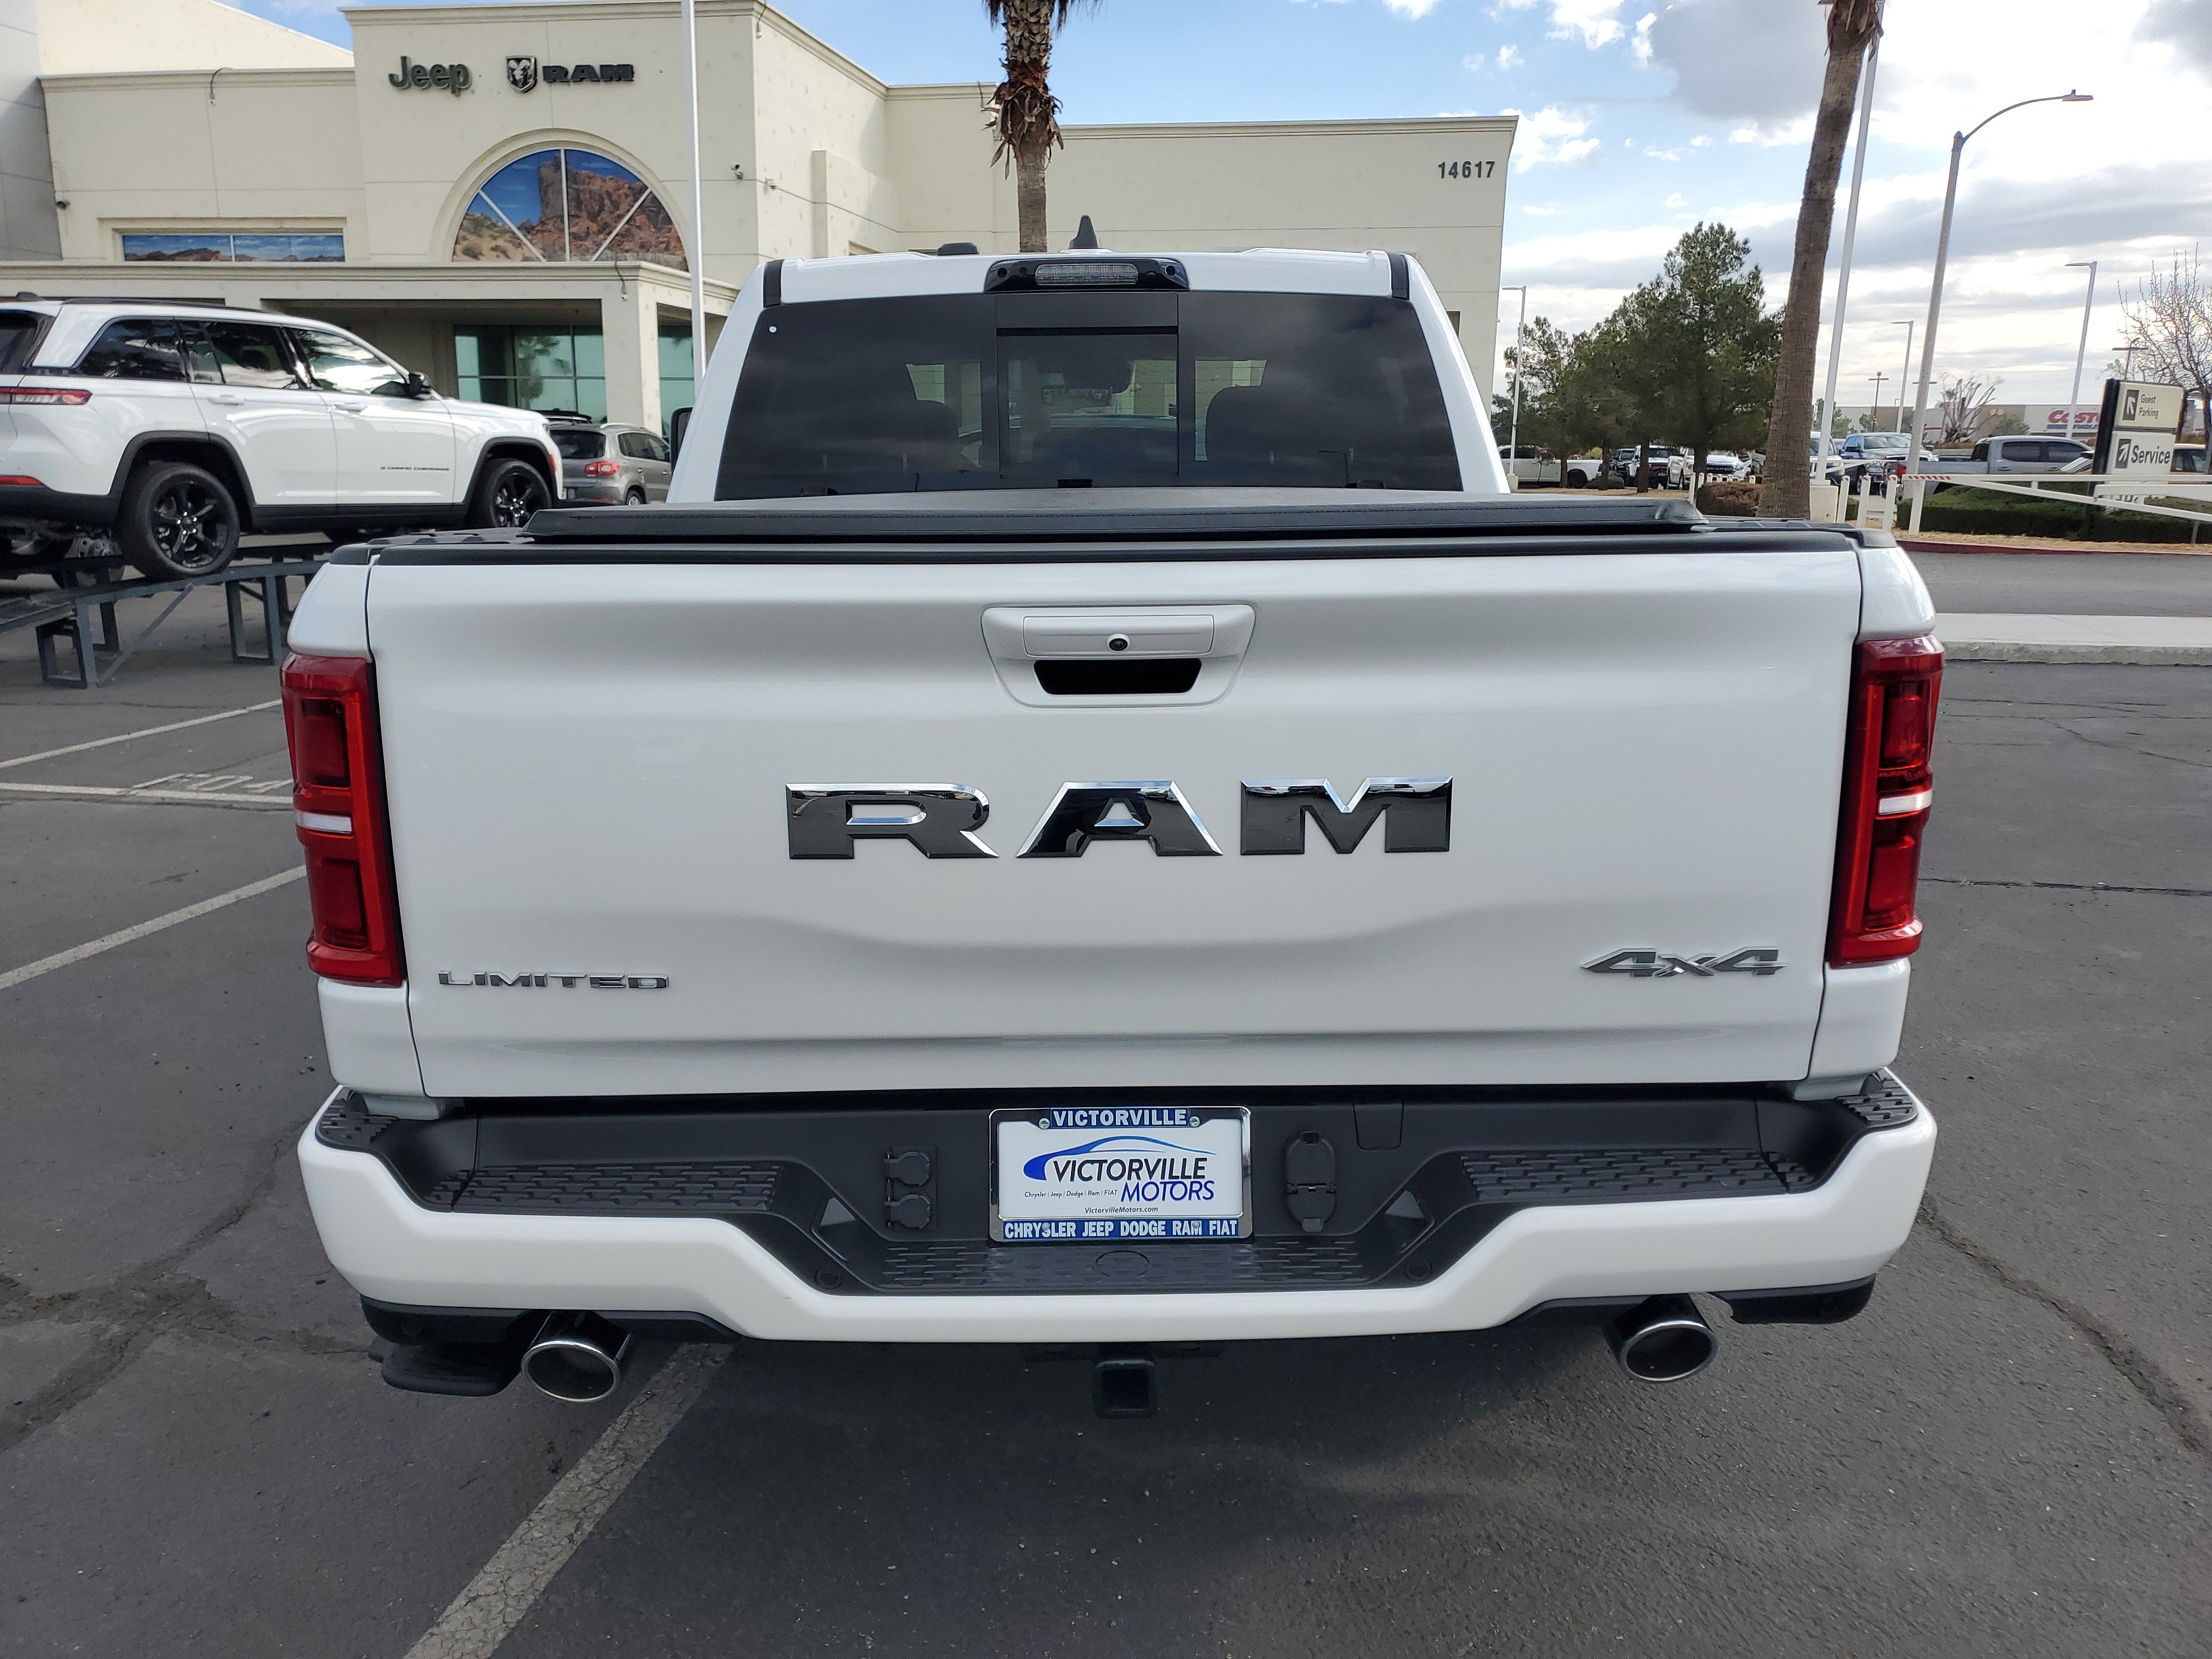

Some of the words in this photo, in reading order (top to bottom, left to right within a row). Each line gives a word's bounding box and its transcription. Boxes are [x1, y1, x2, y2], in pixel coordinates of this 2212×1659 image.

[388, 56, 472, 96] Jeep
[543, 64, 634, 82] RAM
[1438, 161, 1495, 178] 14617
[2141, 394, 2156, 404] Guest
[2139, 407, 2159, 419] Parking
[2131, 445, 2171, 464] Service
[786, 776, 1453, 860] RAM
[438, 971, 669, 988] LIMITED
[1053, 1109, 1187, 1126] VICTORVILLE
[1053, 1157, 1207, 1183] VICTORVILLE
[1024, 1191, 1046, 1199] Chrysler
[1050, 1190, 1062, 1199] Jeep
[1120, 1180, 1215, 1203] MOTORS
[1005, 1221, 1076, 1238] CHRYSLER
[1082, 1221, 1114, 1237] JEEP
[1120, 1221, 1166, 1236] DODGE
[1172, 1220, 1203, 1235] RAM
[1209, 1220, 1237, 1235] FIAT
